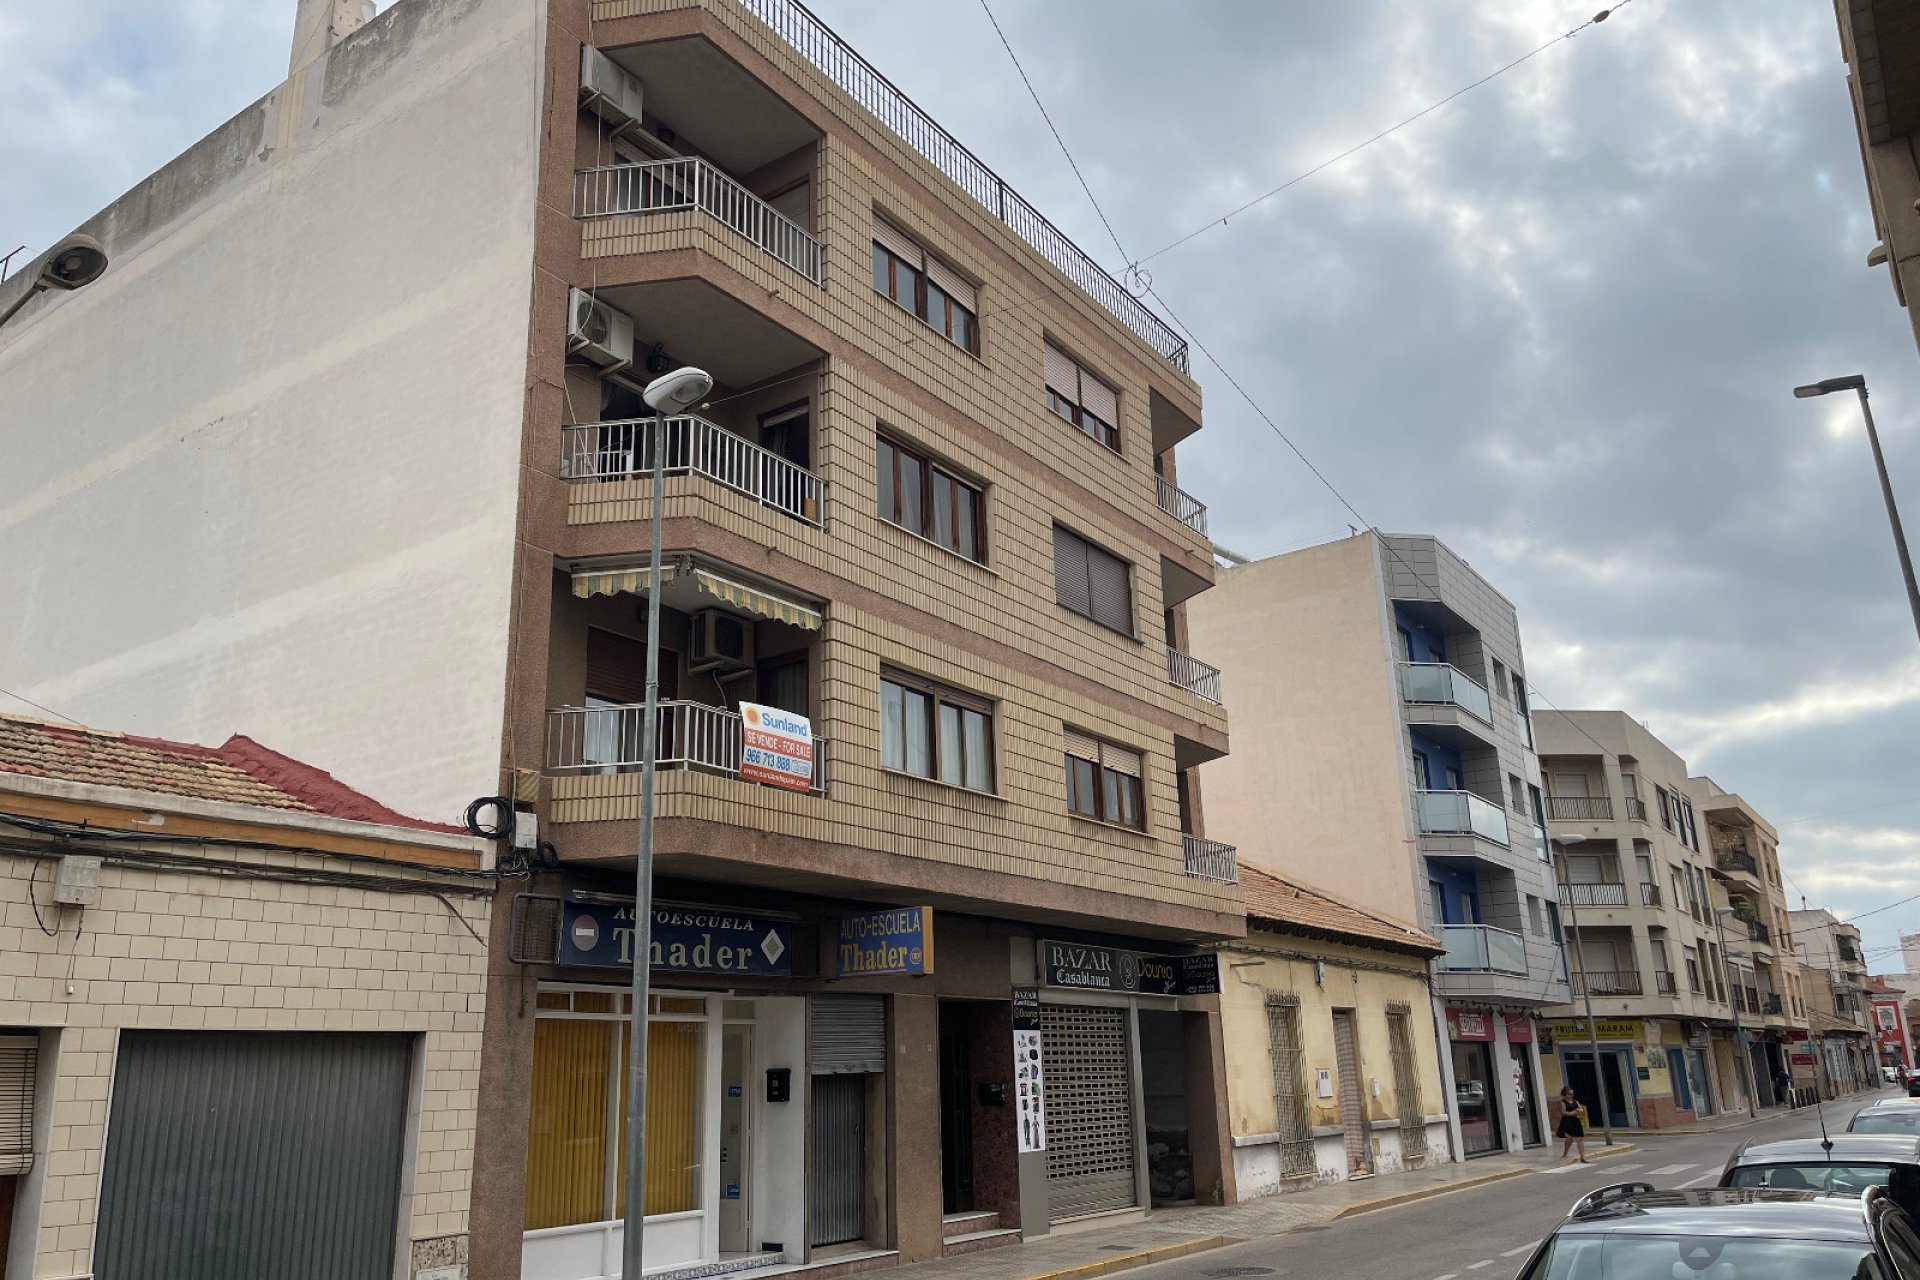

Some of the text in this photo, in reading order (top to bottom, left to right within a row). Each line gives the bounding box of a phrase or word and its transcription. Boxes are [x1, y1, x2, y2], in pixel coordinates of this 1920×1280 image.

[762, 712, 807, 736] Sunland
[747, 731, 756, 744] SE
[757, 734, 778, 750] VENDE
[783, 741, 795, 754] FOR
[796, 744, 811, 758] SALE
[746, 748, 761, 763] 966
[763, 752, 775, 767] 713
[840, 911, 921, 940] AUTO-ESCUELA
[840, 940, 908, 972] Thader
[1051, 946, 1112, 971] BAZAR
[1056, 968, 1110, 987] Casablanca
[1598, 1024, 1634, 1033] MARAM
